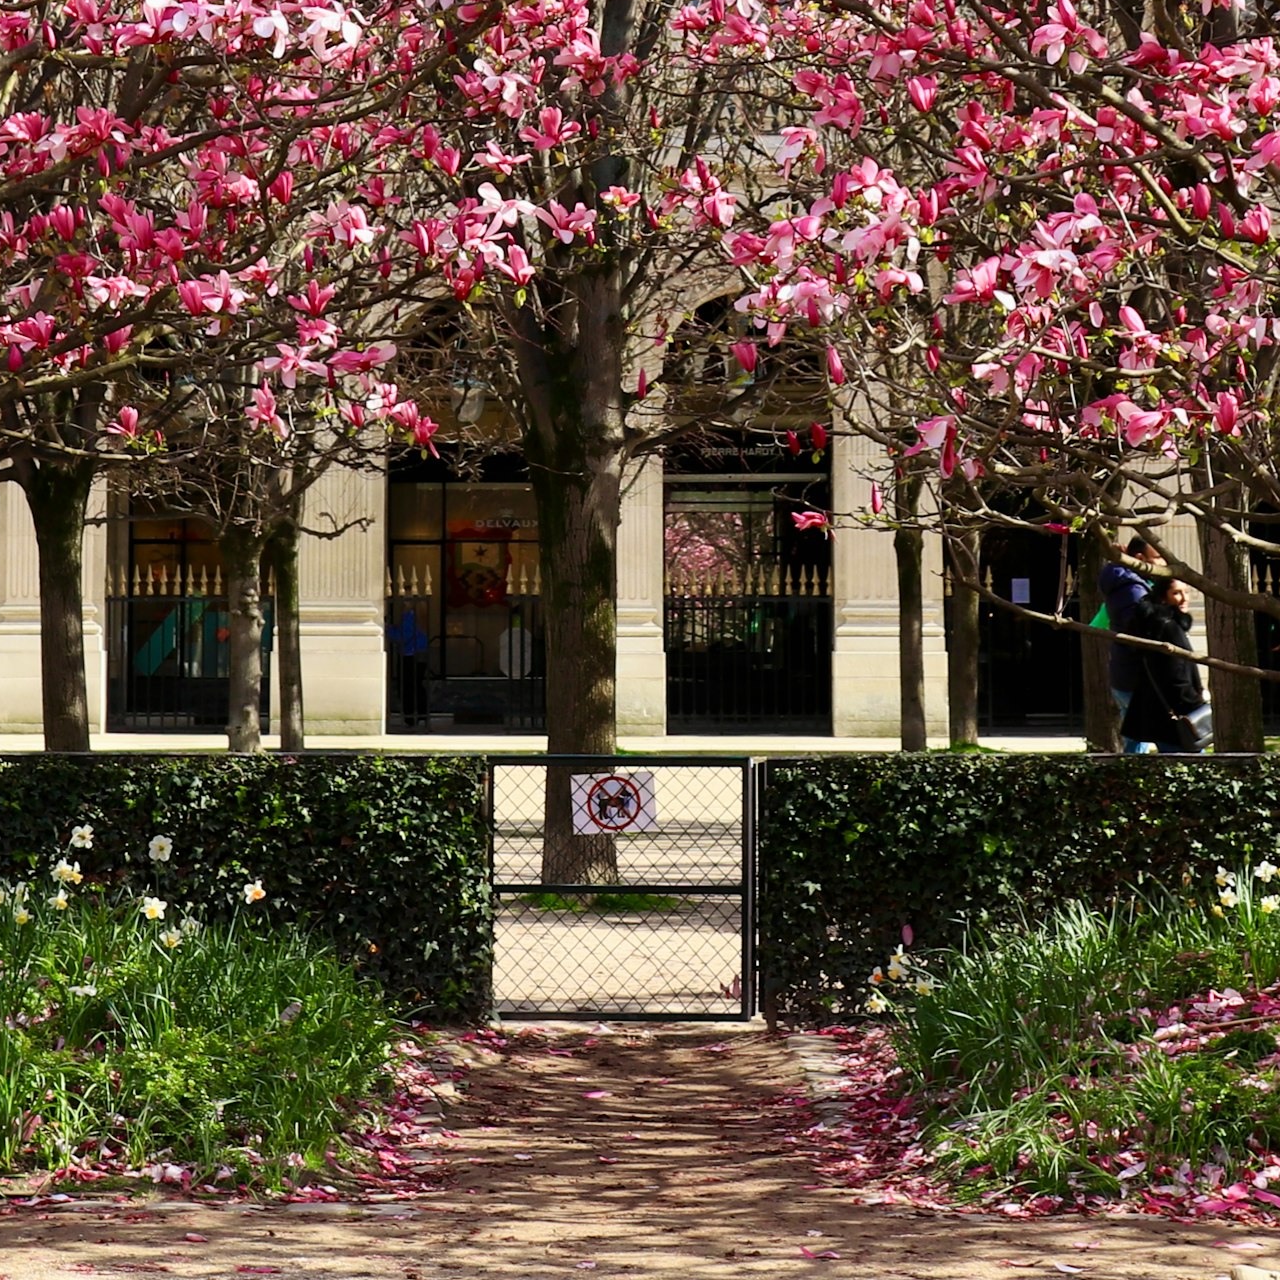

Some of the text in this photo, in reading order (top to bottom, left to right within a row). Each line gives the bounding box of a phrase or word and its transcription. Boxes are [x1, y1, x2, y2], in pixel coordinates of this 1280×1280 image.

[700, 447, 775, 456] PIERRE HARDY
[475, 519, 539, 528] DELVAUX
